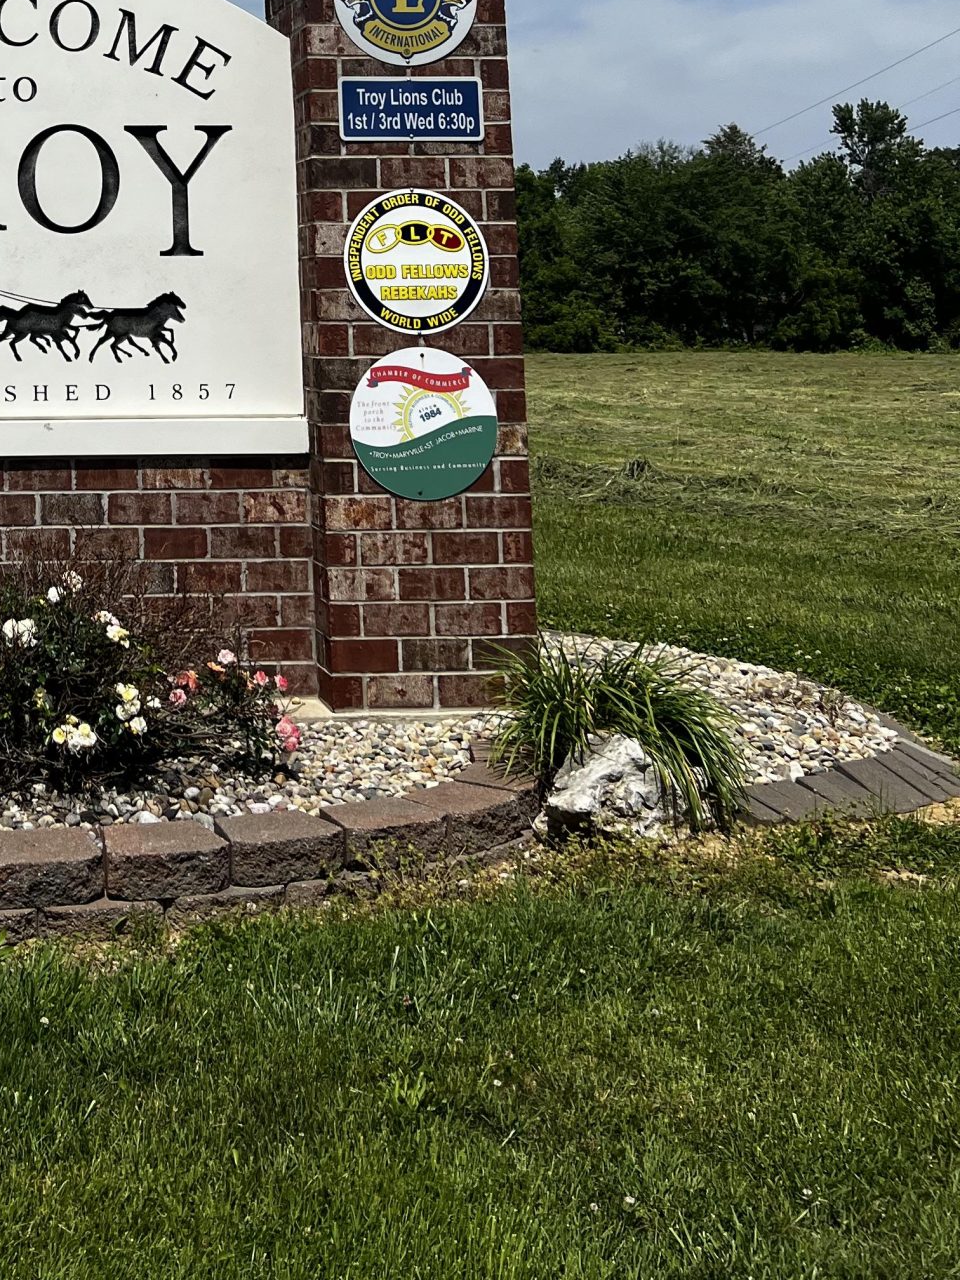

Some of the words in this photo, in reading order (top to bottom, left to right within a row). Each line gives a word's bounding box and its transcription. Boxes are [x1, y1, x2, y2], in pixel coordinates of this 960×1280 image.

[369, 24, 444, 48] INTERNATIONAL
[356, 88, 386, 109] Troy
[390, 88, 428, 106] Lions
[431, 88, 463, 106] Club
[347, 112, 368, 130] 1st
[379, 112, 401, 130] 3rd
[404, 112, 434, 130] Wed
[438, 112, 475, 133] 6:30p
[348, 208, 380, 282] INDEPENDENT
[382, 193, 420, 210] ORDER
[425, 195, 440, 208] OF
[442, 204, 465, 225] ODD
[463, 226, 485, 281] FELLOWS
[375, 232, 388, 247] F
[410, 227, 420, 240] L
[440, 230, 453, 245] T
[365, 265, 397, 280] ODD
[401, 264, 469, 279] FELLOWS
[380, 286, 458, 301] REBEKAHS
[380, 307, 421, 329] WORLD
[427, 307, 459, 328] WIDE
[372, 371, 408, 379] CHAMBER
[412, 373, 422, 382] OF
[425, 377, 467, 388] COMMERCE
[147, 381, 238, 402] 1857
[419, 407, 442, 422] 1984
